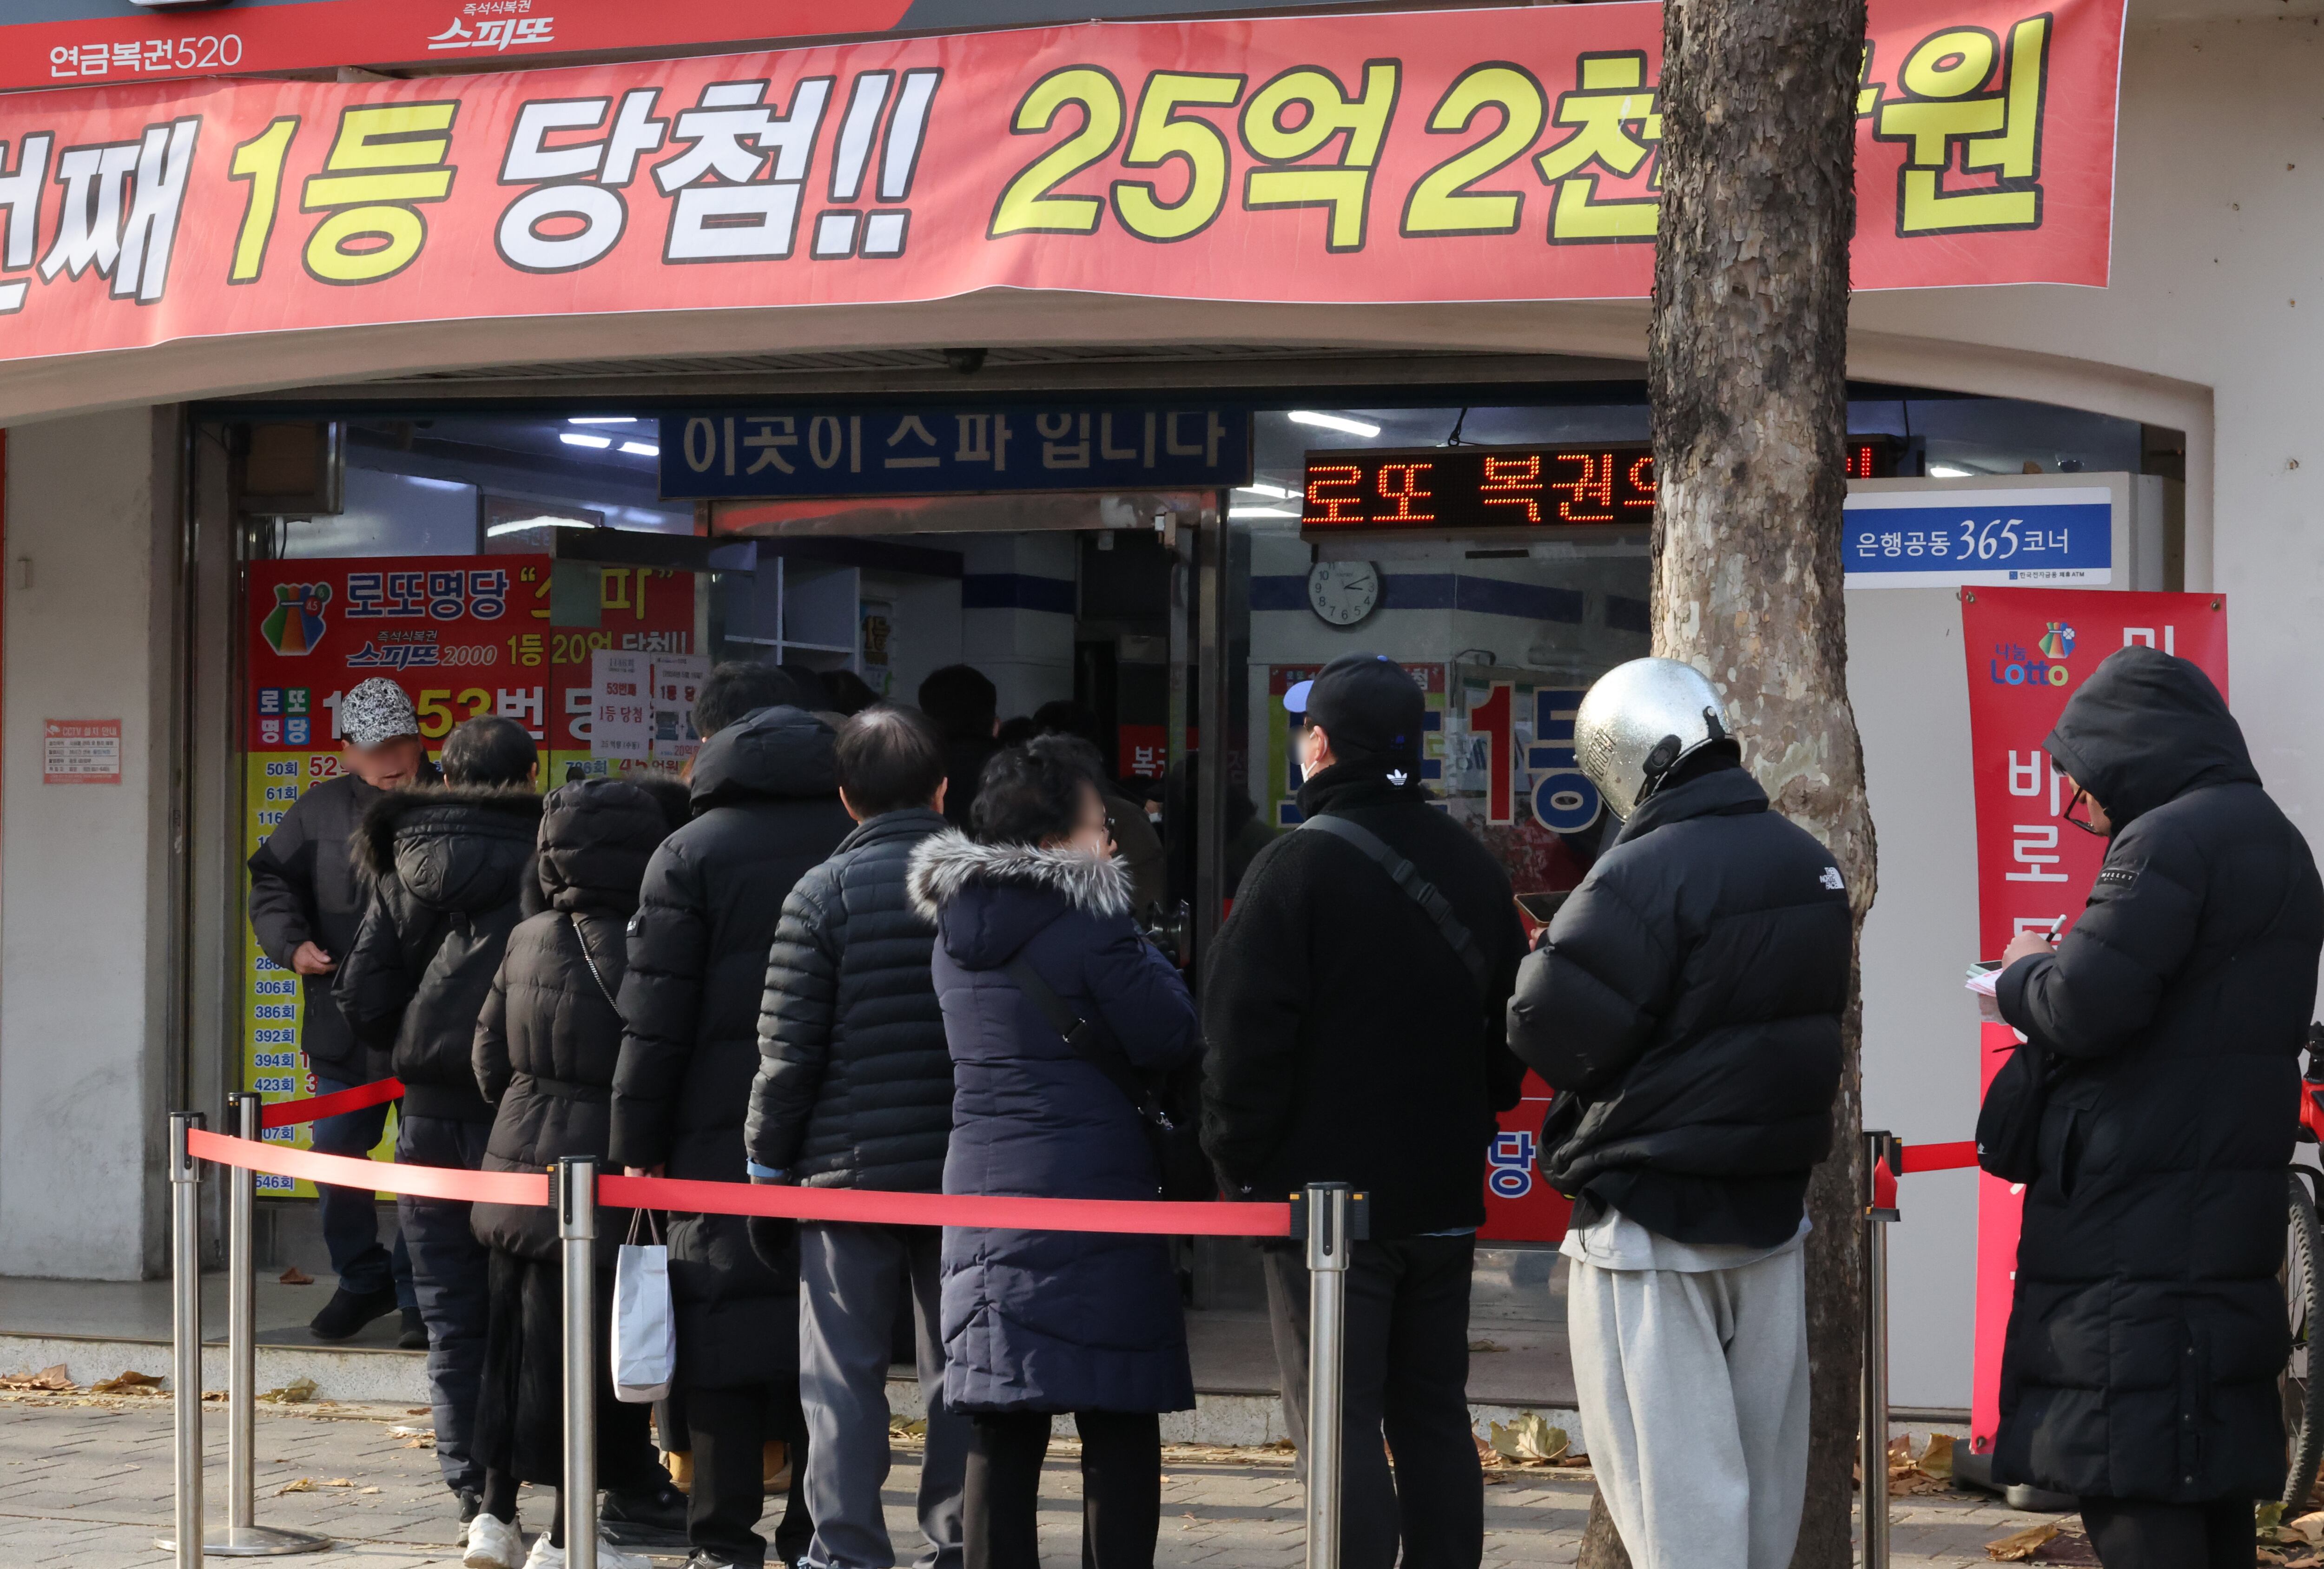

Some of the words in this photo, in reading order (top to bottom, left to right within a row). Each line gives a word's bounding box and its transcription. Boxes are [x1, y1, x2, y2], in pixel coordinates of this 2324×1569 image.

[463, 0, 531, 15] 즉석식복권
[427, 17, 555, 51] 스피또
[50, 34, 242, 77] 연금복권520
[228, 98, 461, 286] 1등
[494, 67, 944, 275] 당첨!!
[985, 58, 1402, 253] 25억
[1400, 12, 2053, 246] 2천원
[683, 416, 861, 475] 이곳이
[885, 415, 1012, 471] 스파
[1037, 412, 1226, 468] 입니다
[1303, 463, 1434, 522] 로또
[1856, 531, 1951, 557] 은행공동
[345, 570, 508, 620] 로또명당
[377, 631, 438, 643] 즉석식복권
[508, 634, 544, 666] 1등
[1995, 643, 2027, 661] 나눔
[1990, 659, 2068, 686] Lotto
[261, 690, 306, 712] 로또
[600, 706, 616, 721] 1등
[621, 706, 642, 723] 당첨
[63, 727, 81, 736] CCTV
[261, 719, 308, 744] 명당
[267, 762, 297, 776] 50회
[310, 757, 350, 776] 52
[266, 786, 298, 801] 61회
[256, 981, 295, 995] 306회
[255, 1005, 294, 1019] 386회
[255, 1029, 294, 1043] 392회
[255, 1054, 294, 1068] 394회
[254, 1078, 294, 1092] 423회
[263, 1127, 294, 1141] 07회
